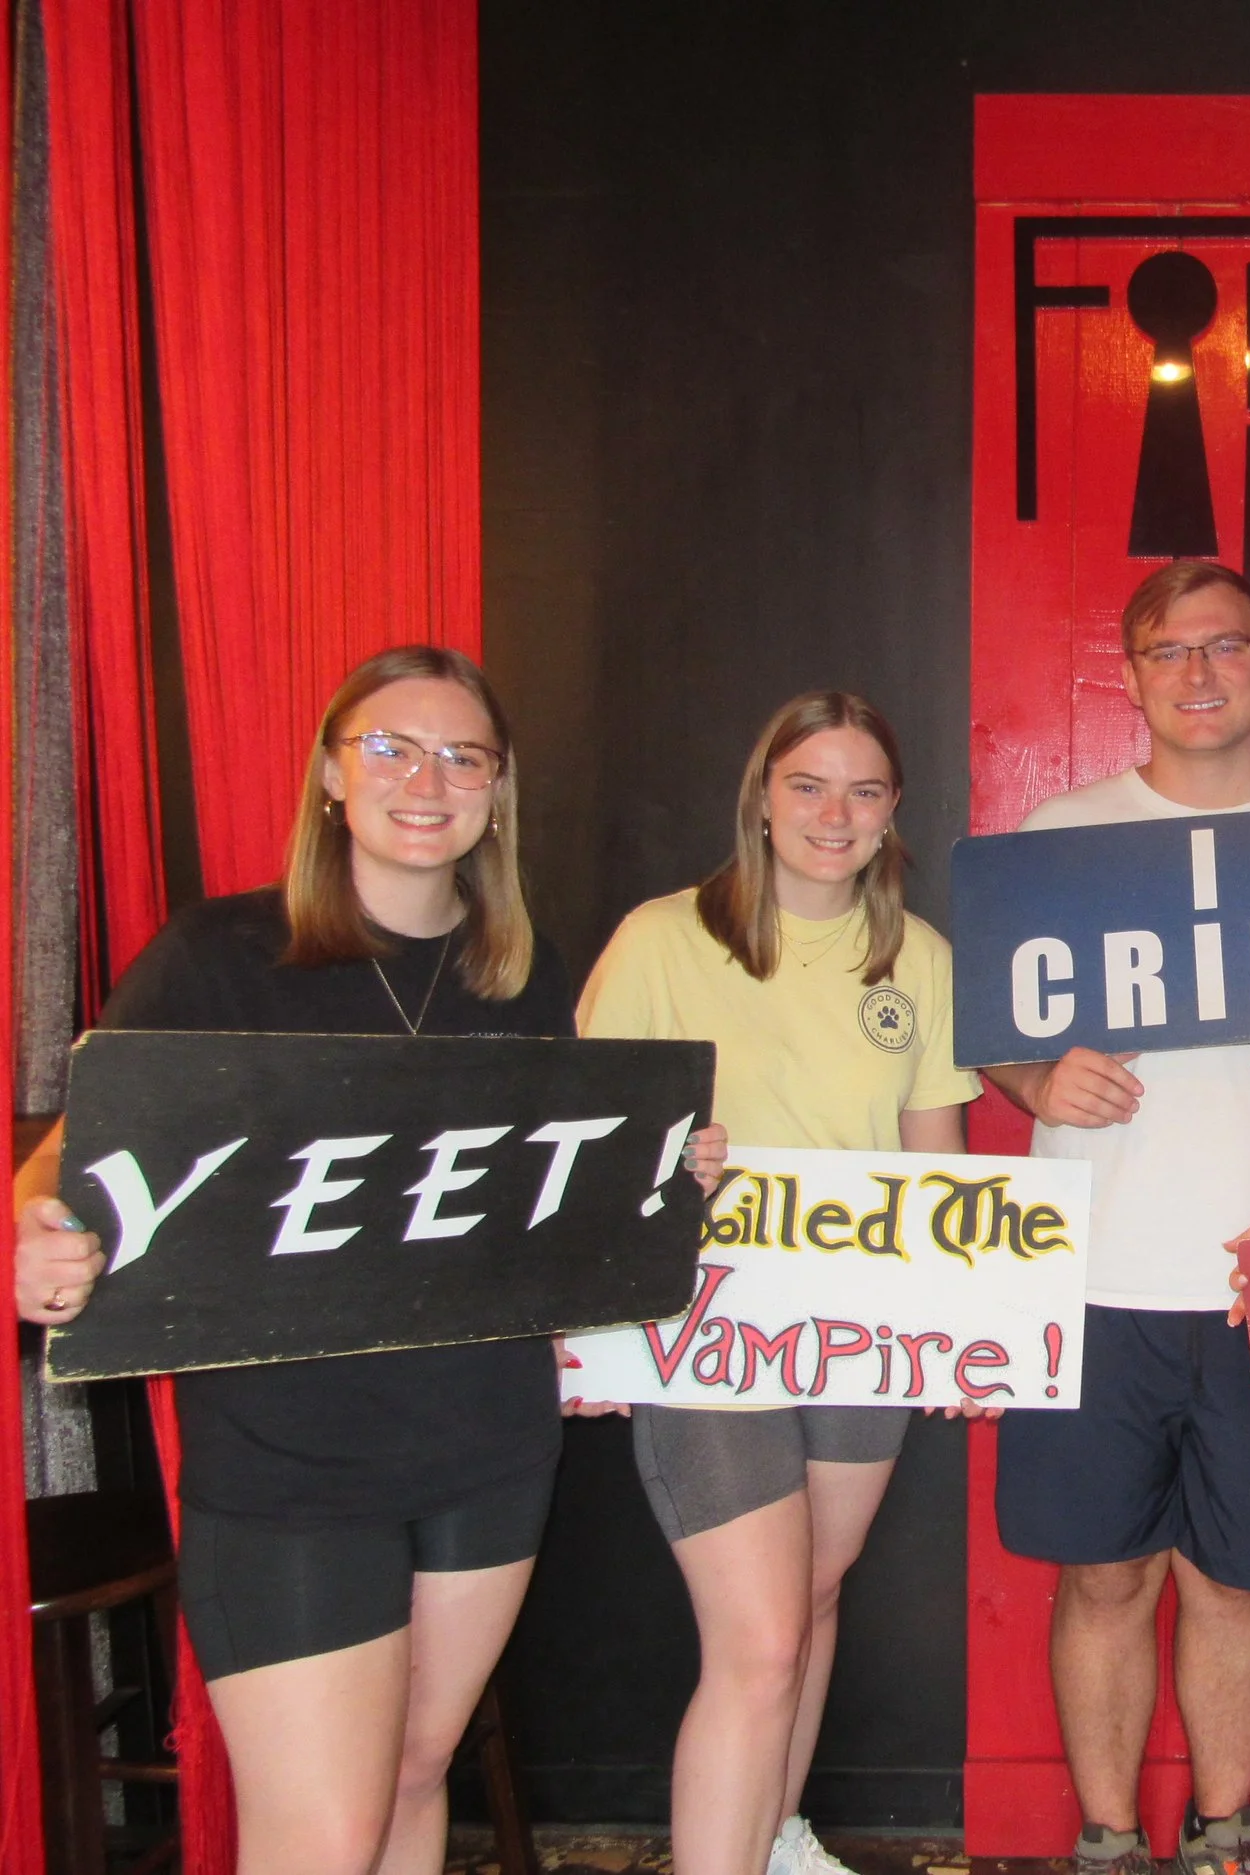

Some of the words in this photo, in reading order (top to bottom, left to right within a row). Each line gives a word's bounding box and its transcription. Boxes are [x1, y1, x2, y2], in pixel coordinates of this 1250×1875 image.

[1191, 828, 1217, 910] I
[867, 994, 891, 1010] GOOD
[894, 998, 911, 1017] DOG
[919, 1172, 1075, 1268] The
